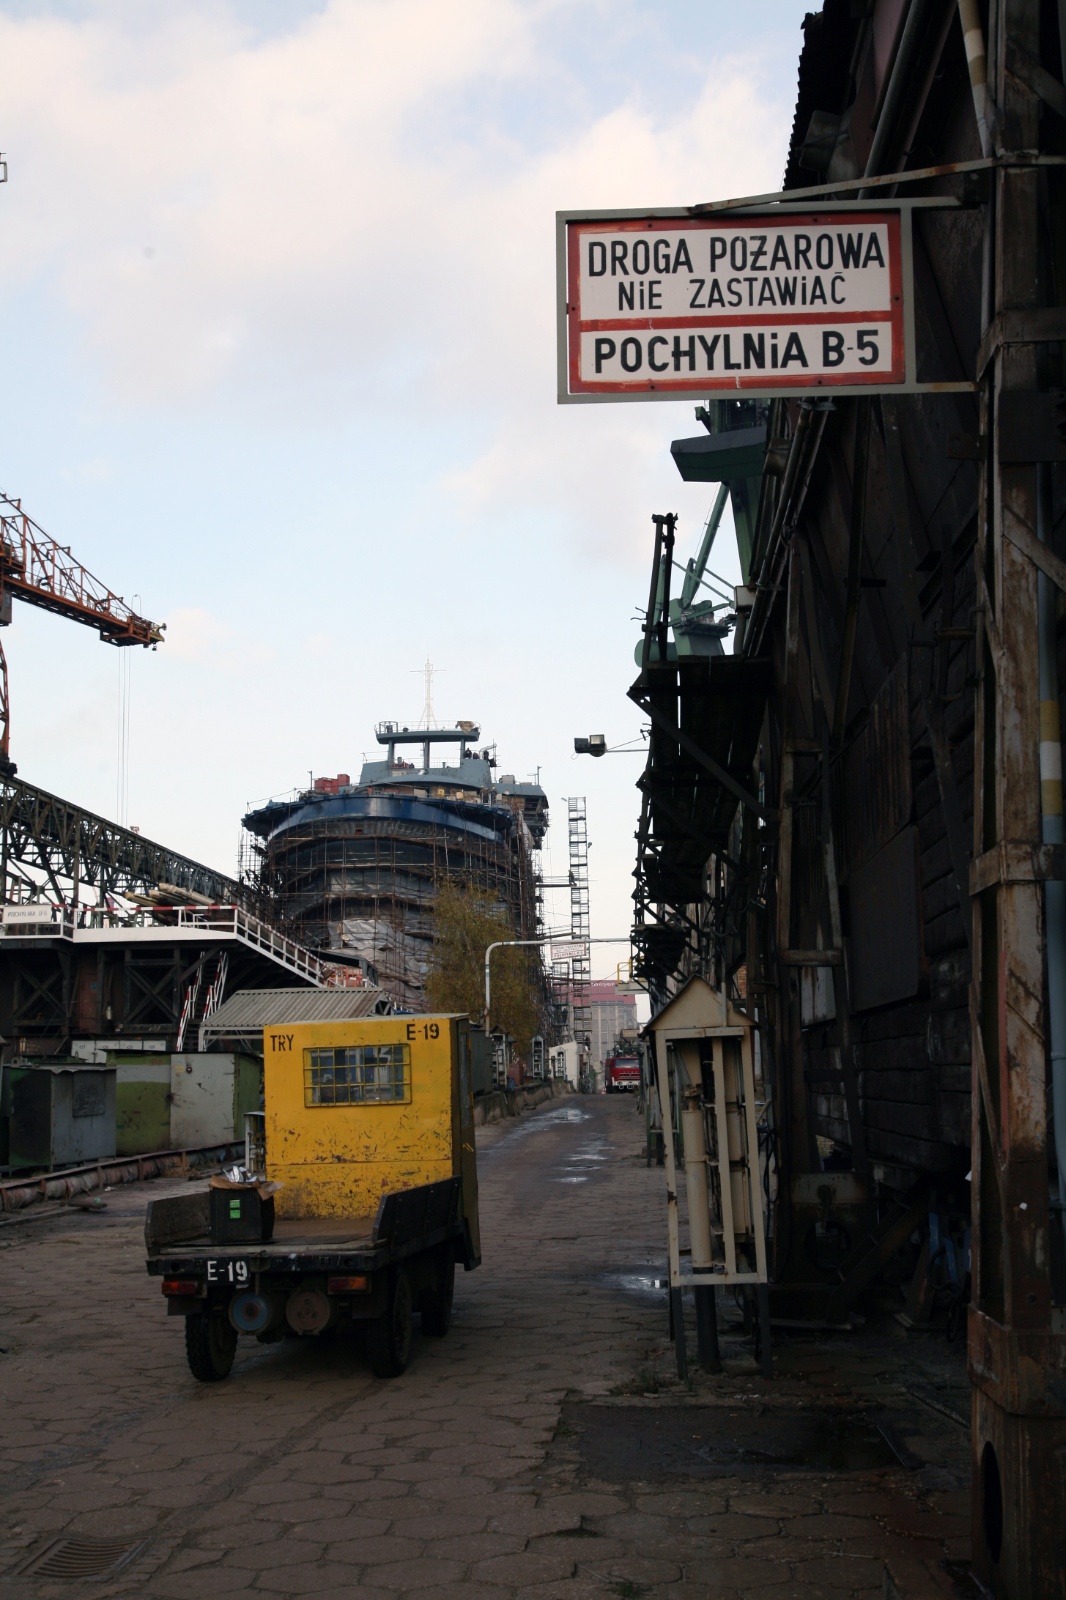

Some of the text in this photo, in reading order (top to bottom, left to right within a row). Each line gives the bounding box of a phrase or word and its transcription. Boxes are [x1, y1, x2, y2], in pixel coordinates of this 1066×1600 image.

[588, 238, 694, 277] DROGA
[822, 329, 880, 367] B-5
[270, 1023, 440, 1052] TRY E-19
[207, 1260, 248, 1282] E-19
